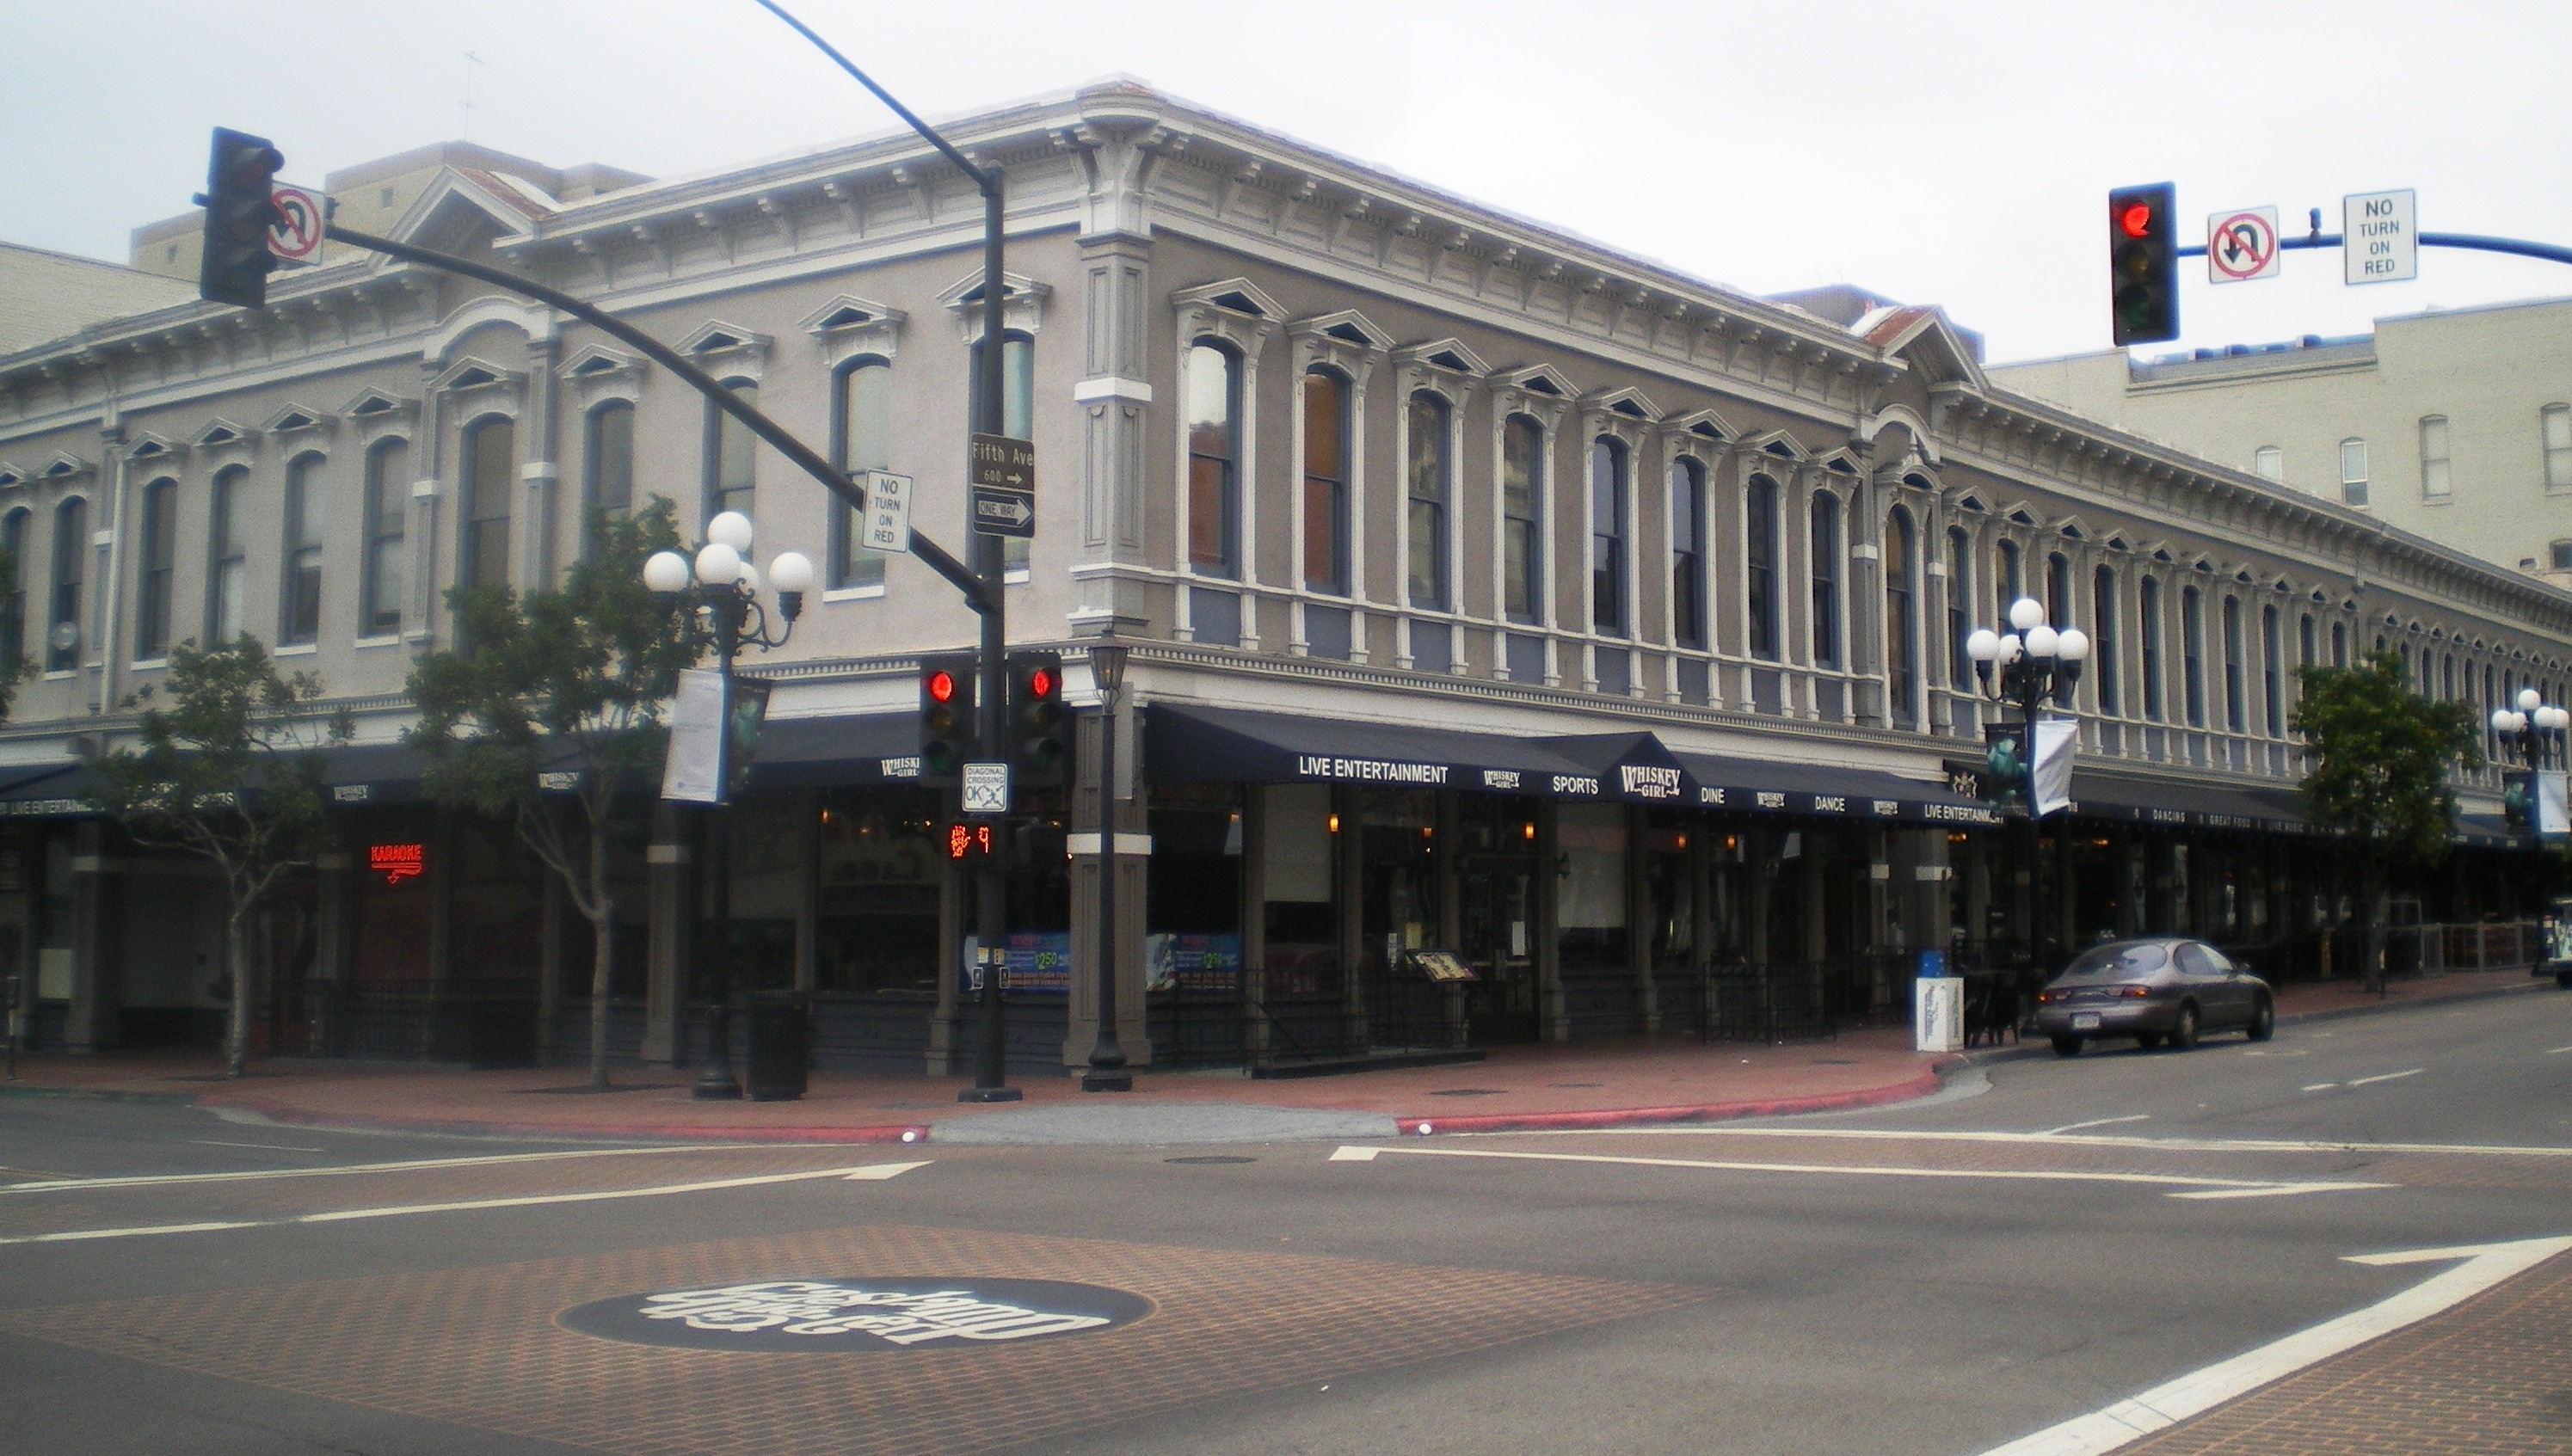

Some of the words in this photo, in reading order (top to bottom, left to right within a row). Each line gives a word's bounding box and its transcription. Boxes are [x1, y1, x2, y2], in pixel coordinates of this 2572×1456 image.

[2366, 199, 2393, 218] NO
[2360, 219, 2399, 237] TURN
[2370, 240, 2390, 255] ON
[2365, 259, 2395, 274] RED
[972, 442, 1005, 463] Fifth
[1012, 447, 1033, 466] Ave
[983, 470, 1001, 482] 600
[880, 478, 898, 495] NO
[875, 497, 901, 511] TURN
[980, 502, 996, 514] ONE
[1000, 504, 1015, 516] WAY
[878, 514, 893, 527] ON
[874, 529, 895, 543] RED
[896, 769, 919, 777] GIRL
[1300, 756, 1332, 776] LIVE
[1334, 759, 1449, 783] ENTERTAINMENT
[1483, 771, 1520, 788] WHISKEY
[1553, 776, 1599, 795] SPORTS
[1621, 765, 1681, 796] WHISKEY
[965, 786, 982, 801] OK
[1641, 784, 1667, 798] GIRL
[1701, 787, 1725, 804] DINE
[1815, 796, 1846, 812] DANCE
[1924, 804, 1942, 819] LIVE
[979, 826, 989, 853] 9
[371, 845, 421, 861] KARAOKE
